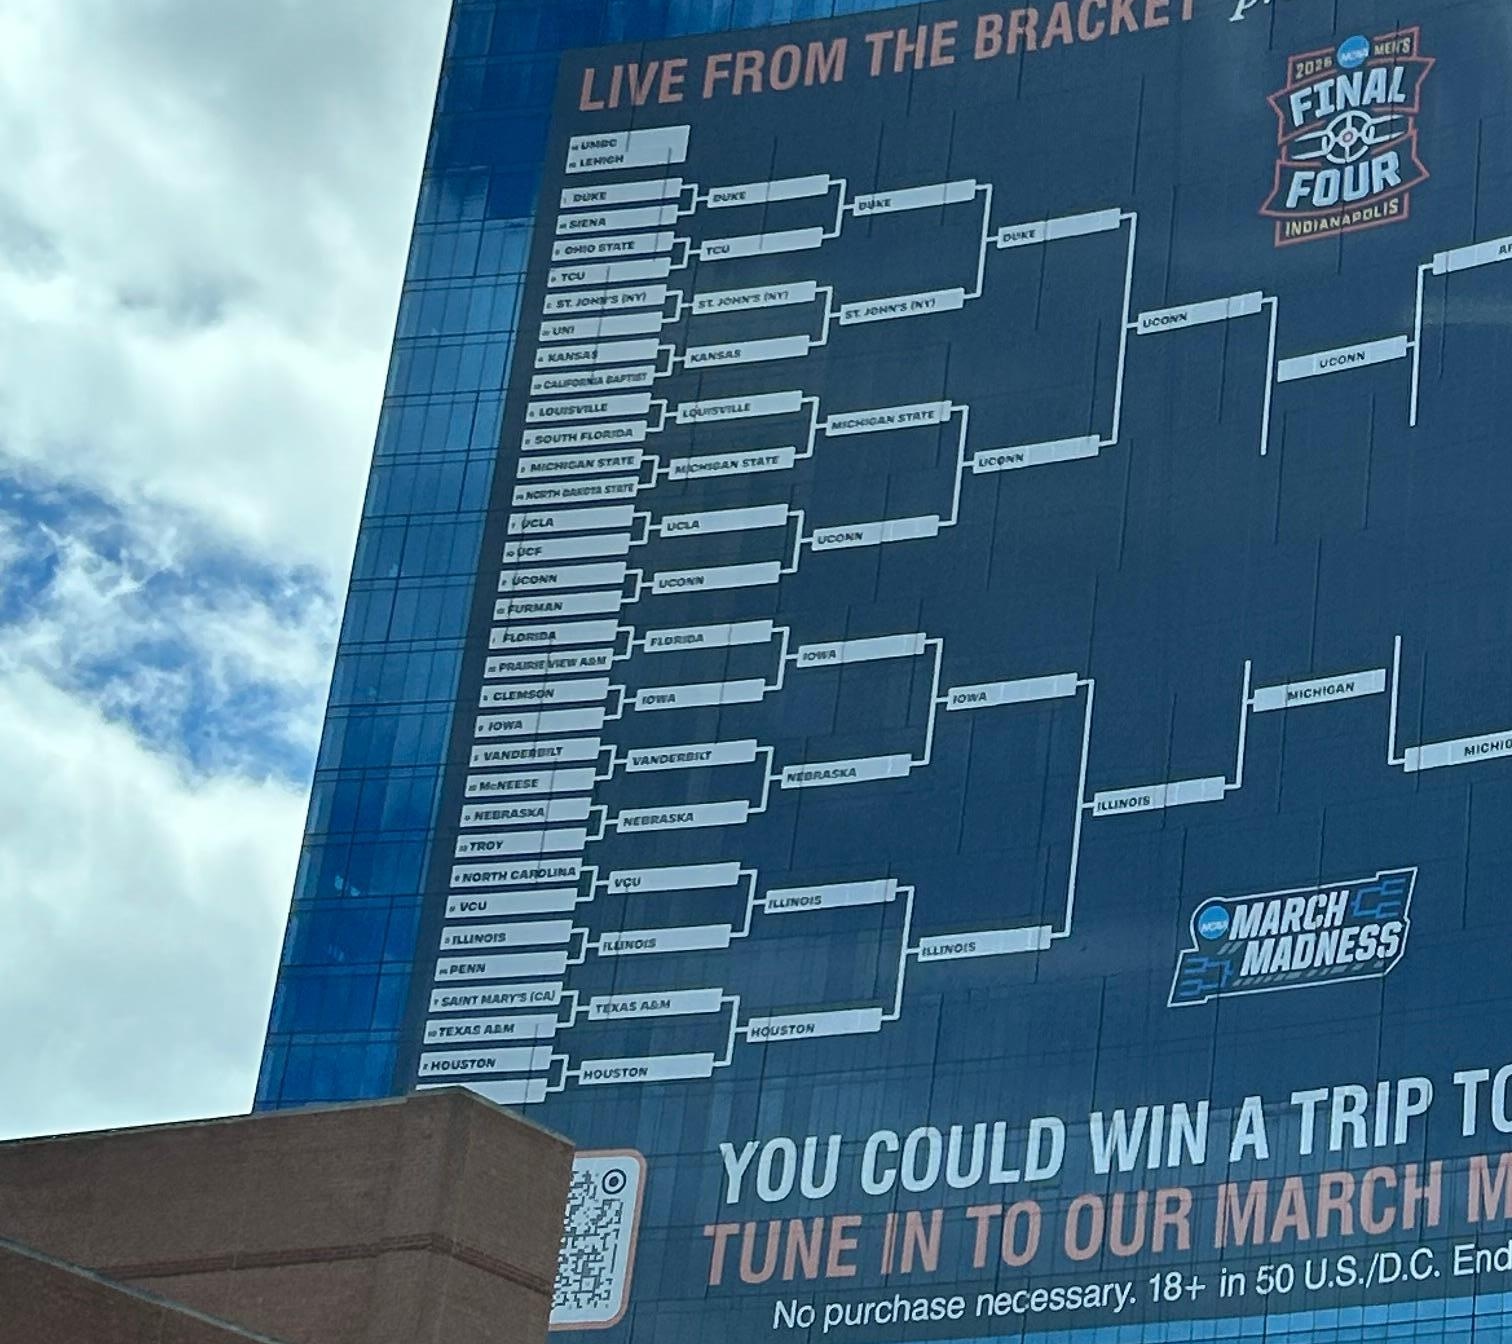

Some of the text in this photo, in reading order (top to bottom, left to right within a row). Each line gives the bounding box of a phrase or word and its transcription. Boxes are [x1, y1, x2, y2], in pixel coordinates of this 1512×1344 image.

[579, 60, 682, 112] LIVE
[702, 36, 848, 99] FROM
[867, 24, 959, 77] THE
[1297, 56, 1333, 79] 2026
[1290, 66, 1406, 127] FINAL
[1286, 151, 1402, 209] FOUR
[1285, 198, 1399, 237] INDIANAPOLIS
[599, 240, 635, 253] STATE
[1143, 313, 1187, 328] UCONN
[1320, 351, 1365, 369] UCONN
[539, 403, 608, 416] LOUISVILLE
[978, 453, 1024, 467] UCONN
[667, 520, 700, 531] UCLA
[493, 688, 555, 701] CLEMSON
[952, 692, 987, 704] IOWA
[1286, 682, 1355, 701] MICHIGAN
[632, 751, 712, 765] VANDERBILT
[787, 767, 857, 783] NEBRASKA
[1097, 795, 1150, 812] ILLINOIS
[469, 841, 504, 851] TROY
[462, 866, 577, 882] NORTH CAROLINA
[614, 876, 641, 888] VCU
[1229, 890, 1350, 941] MARCH
[921, 942, 976, 956] ILLINOIS
[1240, 921, 1403, 977] MADNESS
[450, 963, 486, 975] PENN
[596, 1001, 638, 1013] TEXAS
[751, 1023, 815, 1038] HOUSTON
[432, 1058, 496, 1071] HOUSTON
[720, 1133, 840, 1204] YOU
[859, 1114, 1066, 1197] COULD
[1090, 1097, 1208, 1175] WIN
[1229, 1094, 1270, 1162] A
[1290, 1077, 1434, 1155] TRIP
[703, 1214, 861, 1287] TUNE
[882, 1208, 938, 1277] IN
[966, 1197, 1042, 1268] TO
[1064, 1187, 1192, 1259] OUR
[1215, 1161, 1442, 1250] MARCH
[773, 1297, 816, 1328] No
[824, 1290, 967, 1334] purchase
[975, 1279, 1137, 1322] necessary.
[1147, 1270, 1208, 1301] 18+
[1220, 1268, 1246, 1296] in
[1256, 1263, 1296, 1294] 50
[1304, 1250, 1441, 1291] U.S./D.C.
